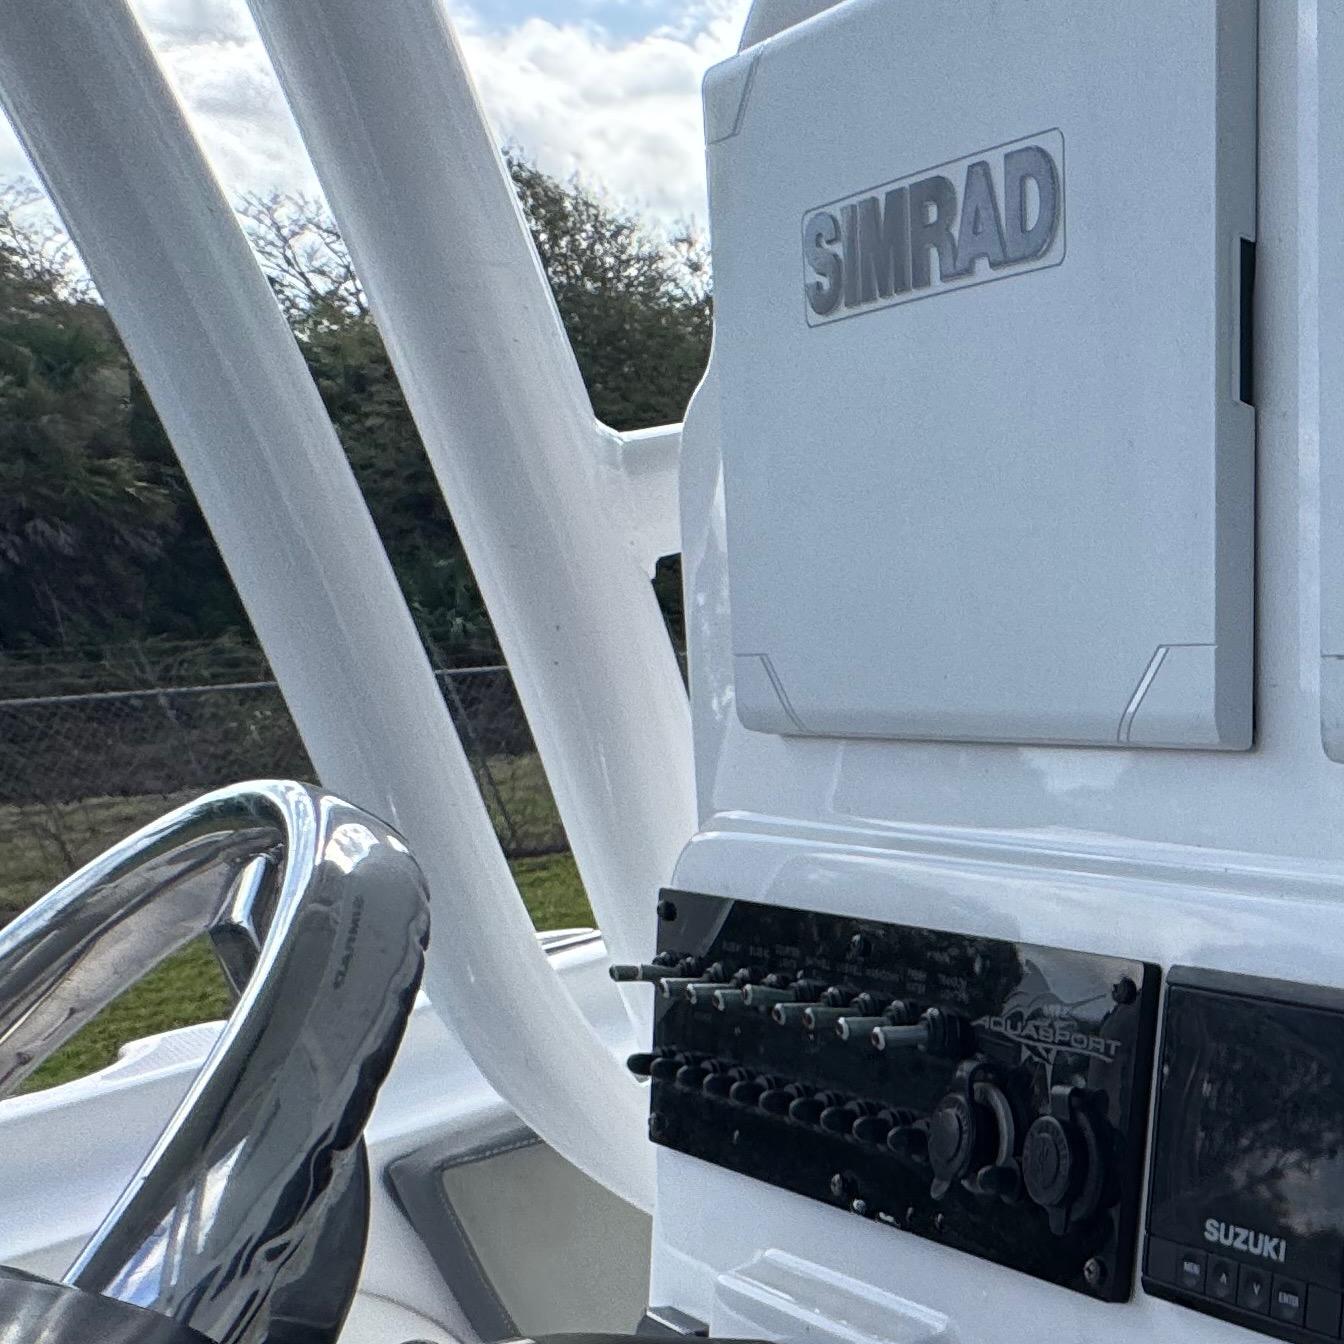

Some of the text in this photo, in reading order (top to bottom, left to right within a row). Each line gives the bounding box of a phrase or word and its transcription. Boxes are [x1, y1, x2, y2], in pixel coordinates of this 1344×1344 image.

[804, 145, 1058, 317] SIMRAD
[970, 1015, 1122, 1056] AQUASPORT
[1204, 1218, 1287, 1263] SUZUKI
